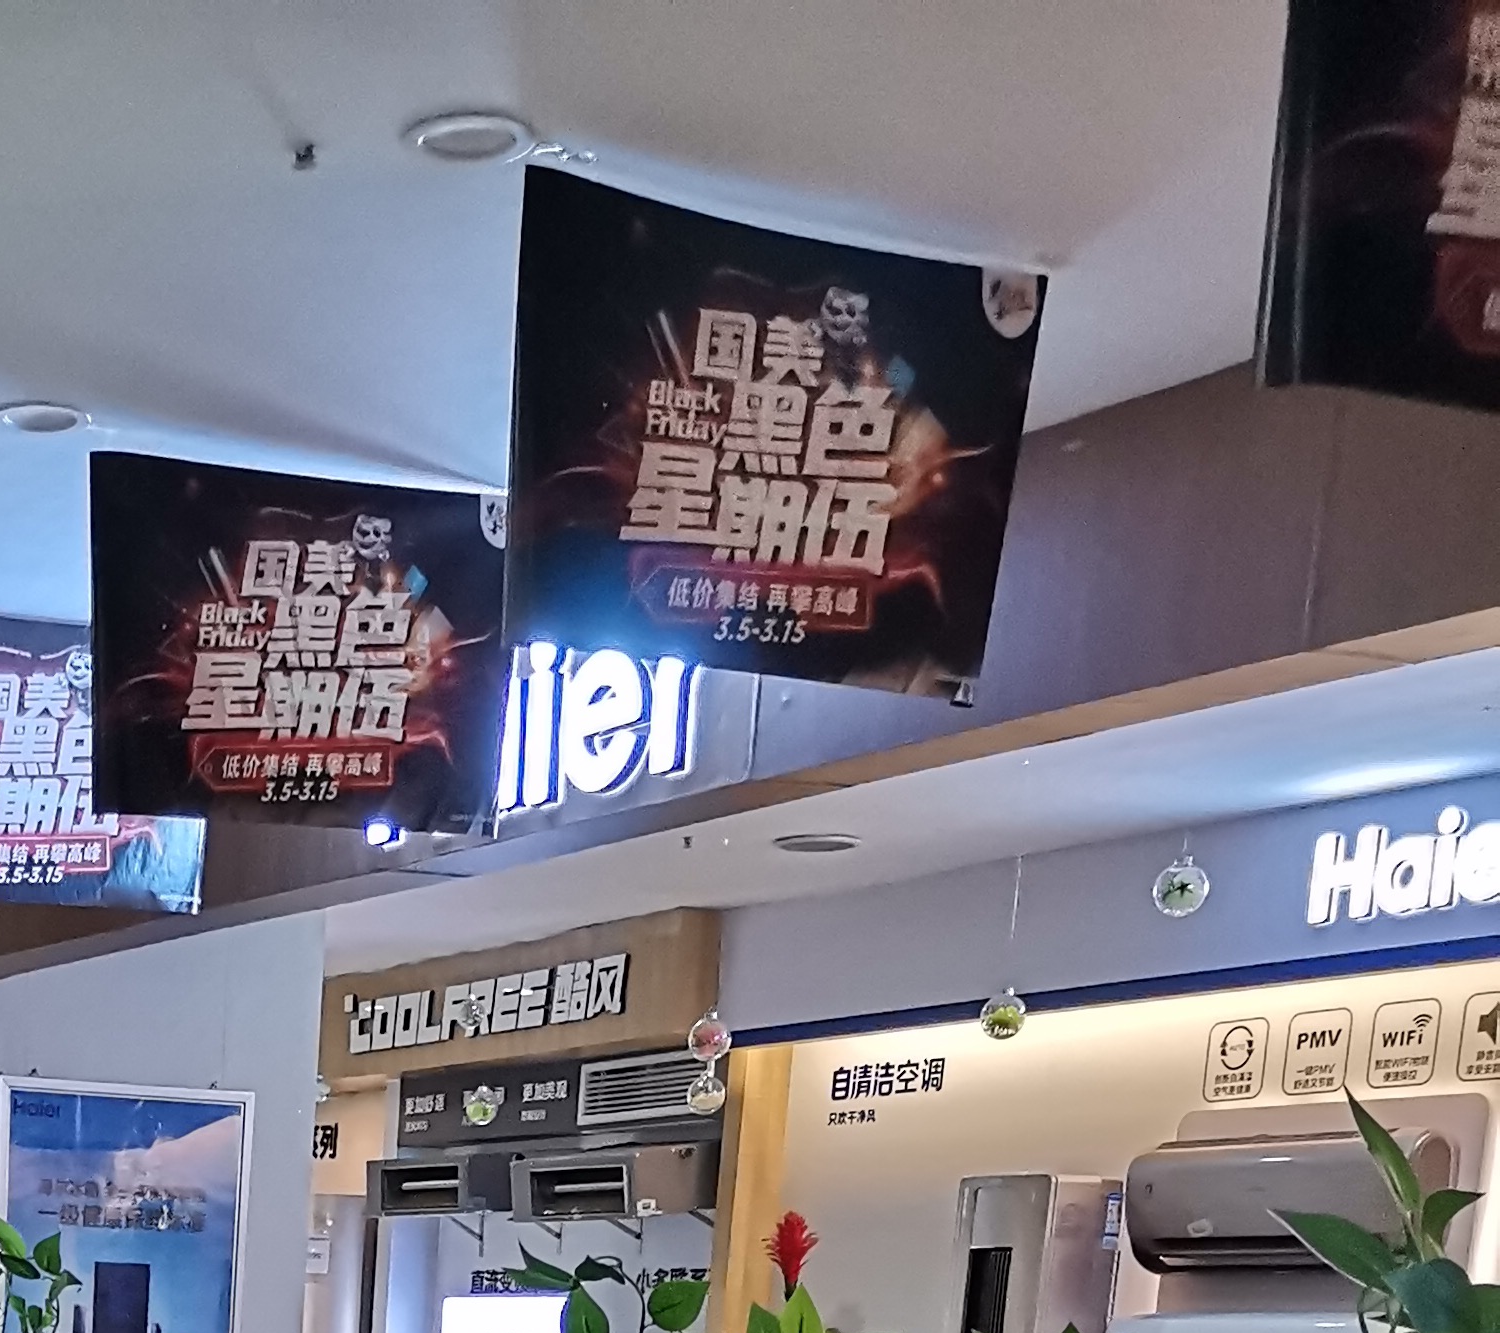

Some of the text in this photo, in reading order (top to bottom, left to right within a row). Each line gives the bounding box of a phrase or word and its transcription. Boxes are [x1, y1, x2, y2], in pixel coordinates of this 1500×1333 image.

[691, 308, 825, 387] 国美
[647, 379, 722, 414] Black
[644, 407, 727, 447] Friday
[718, 379, 897, 478] 黑色
[619, 441, 898, 576] 星期伍
[240, 540, 356, 598] 国美
[200, 602, 268, 626] Black
[666, 576, 760, 611] 低价集结
[197, 625, 271, 652] Friday
[262, 591, 411, 669] 黑色
[713, 617, 807, 645] 3.5-3.15
[181, 651, 413, 742] 星期伍
[499, 641, 701, 816] ier
[221, 753, 301, 780] 低价集结
[260, 780, 340, 803] 3.5-3.15
[345, 953, 629, 1055] COOLFREE 酷风
[1296, 1028, 1343, 1051] PMV
[831, 1057, 946, 1101] 自清洁空调
